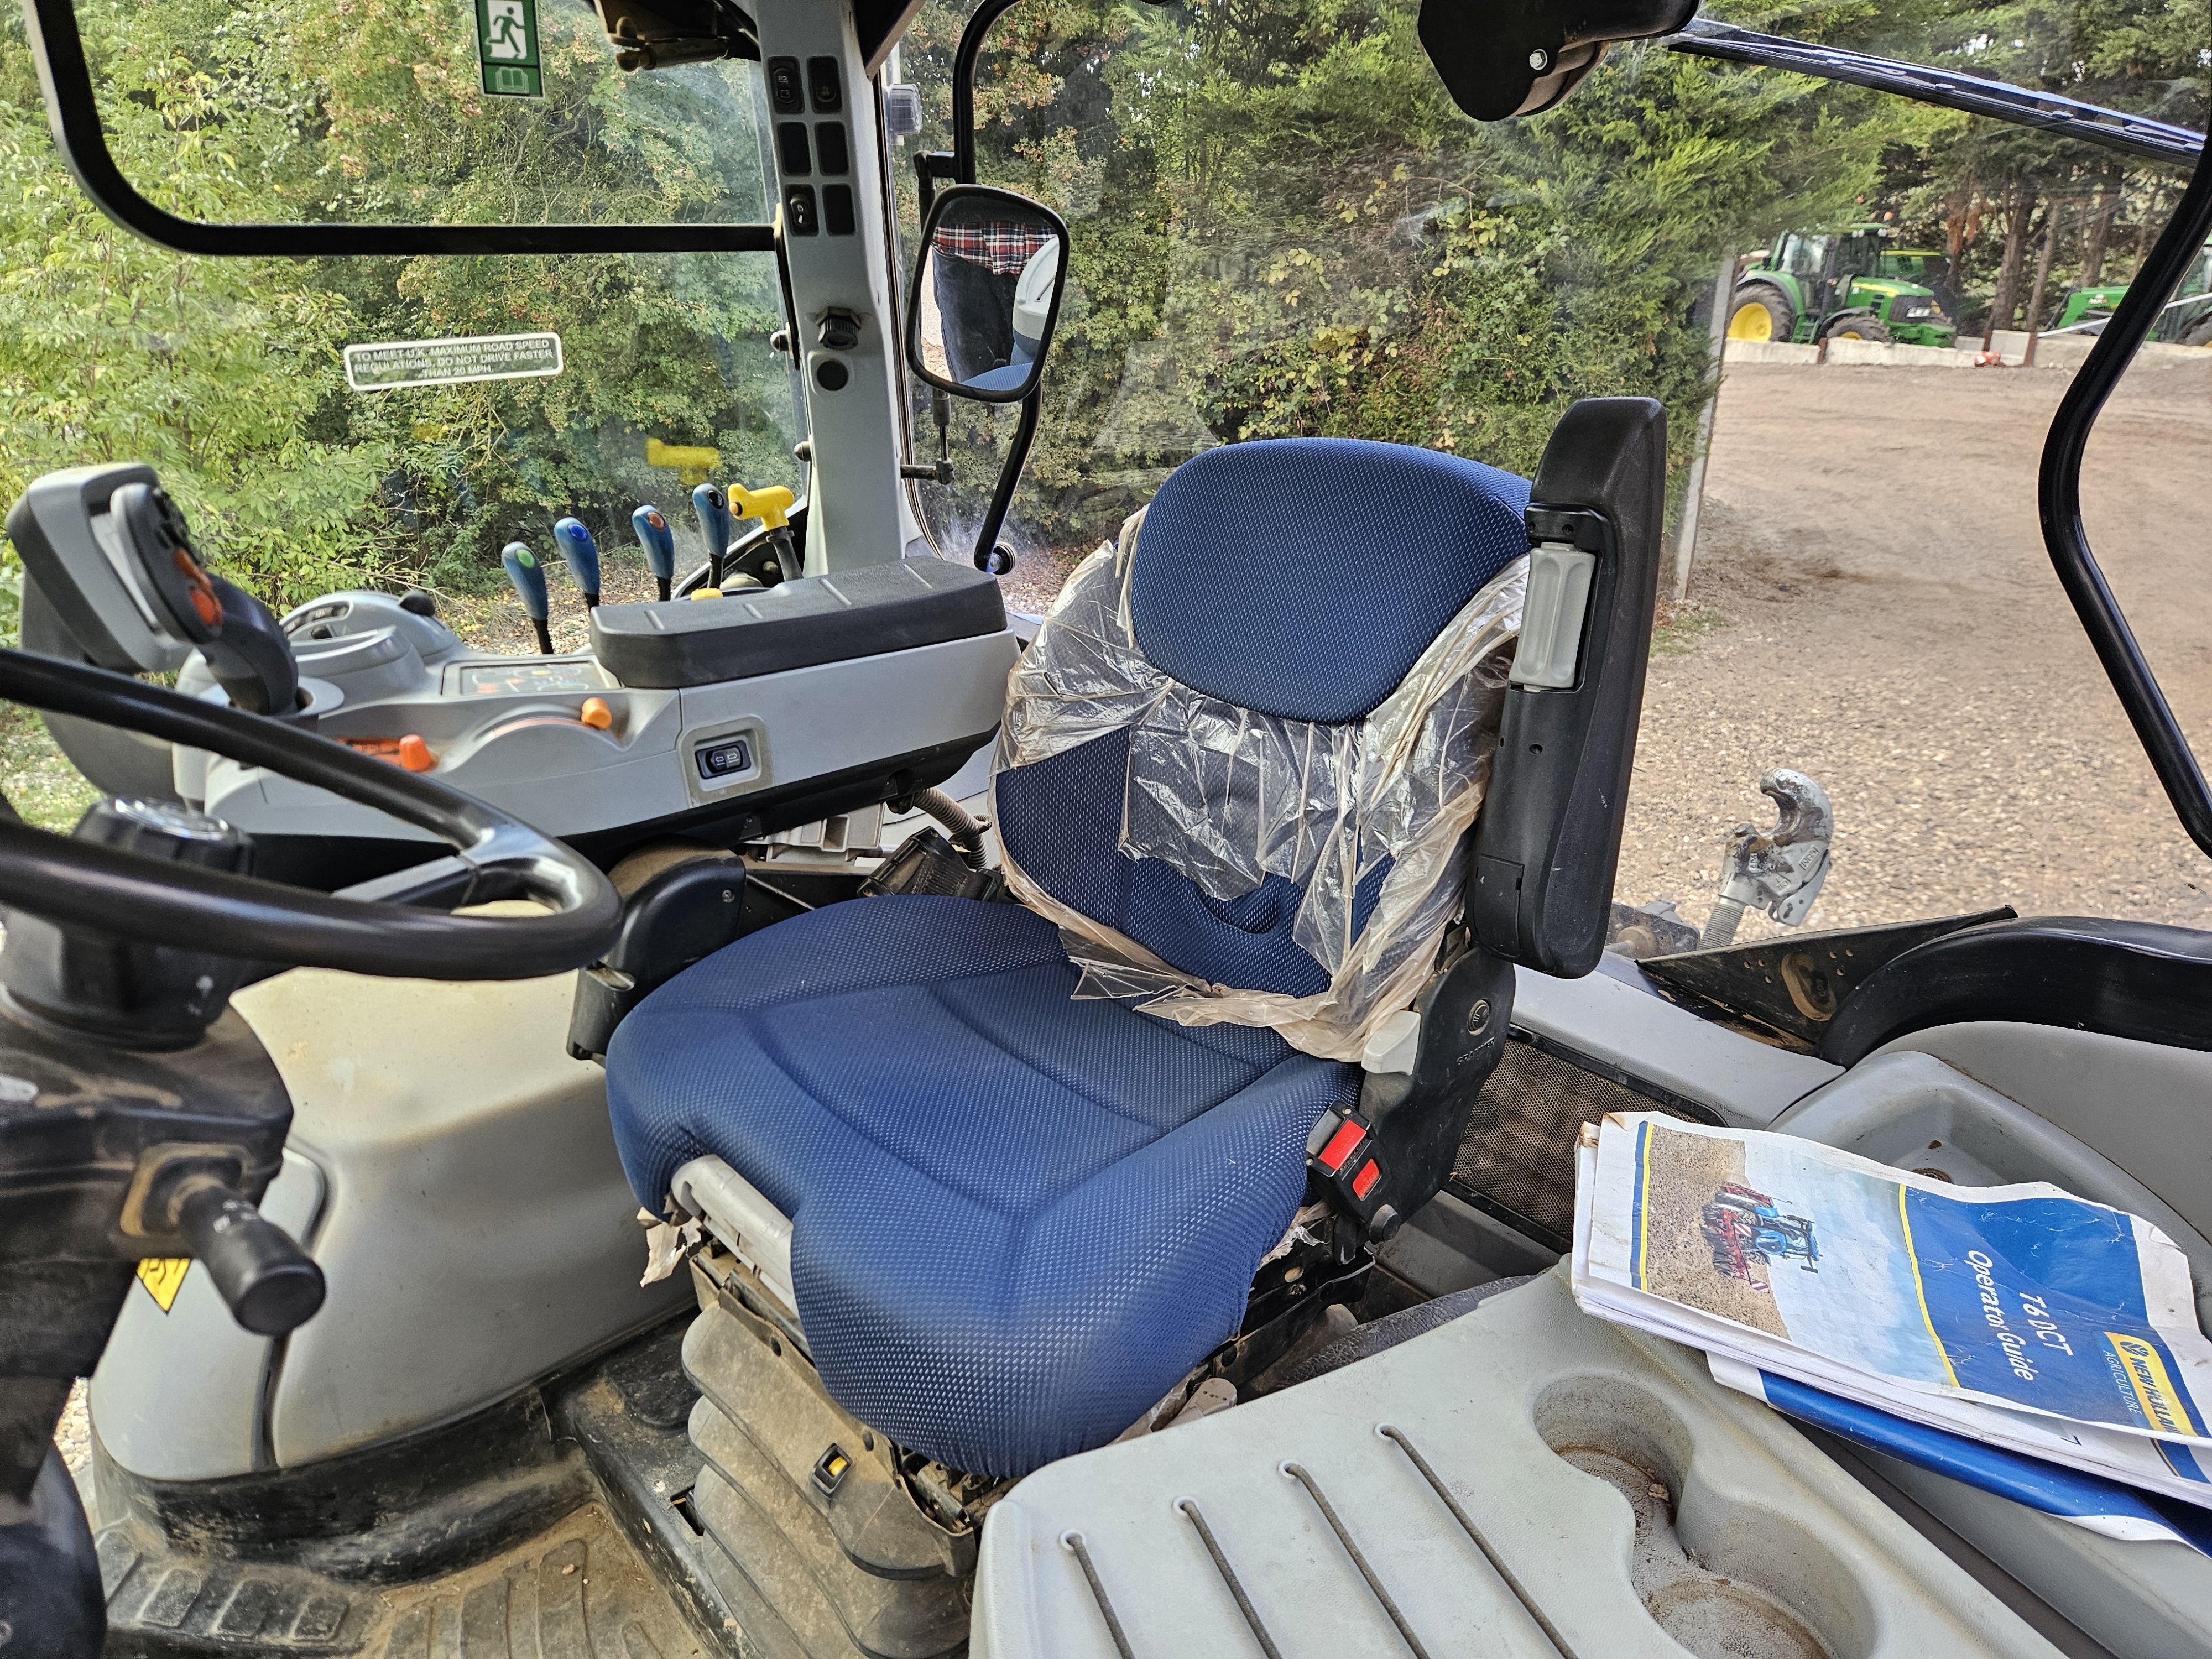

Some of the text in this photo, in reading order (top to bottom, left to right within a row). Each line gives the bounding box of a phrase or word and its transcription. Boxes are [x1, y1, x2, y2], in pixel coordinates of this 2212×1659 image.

[355, 352, 371, 362] TO
[373, 349, 405, 361] MEET
[430, 343, 481, 357] MAXIMUM
[484, 341, 513, 353] ROAD
[515, 338, 549, 351] SPEED
[437, 356, 453, 367] DO
[456, 354, 477, 365] NOT
[480, 351, 512, 363] DRIVE
[513, 348, 554, 361] FASTER
[422, 367, 451, 379] THAN
[453, 365, 466, 376] 20
[1964, 1250, 2039, 1381] Operator Guide
[2019, 1292, 2074, 1357] T6 DCT
[2103, 1350, 2143, 1416] AGRICULTURE
[2129, 1357, 2157, 1387] NEW
